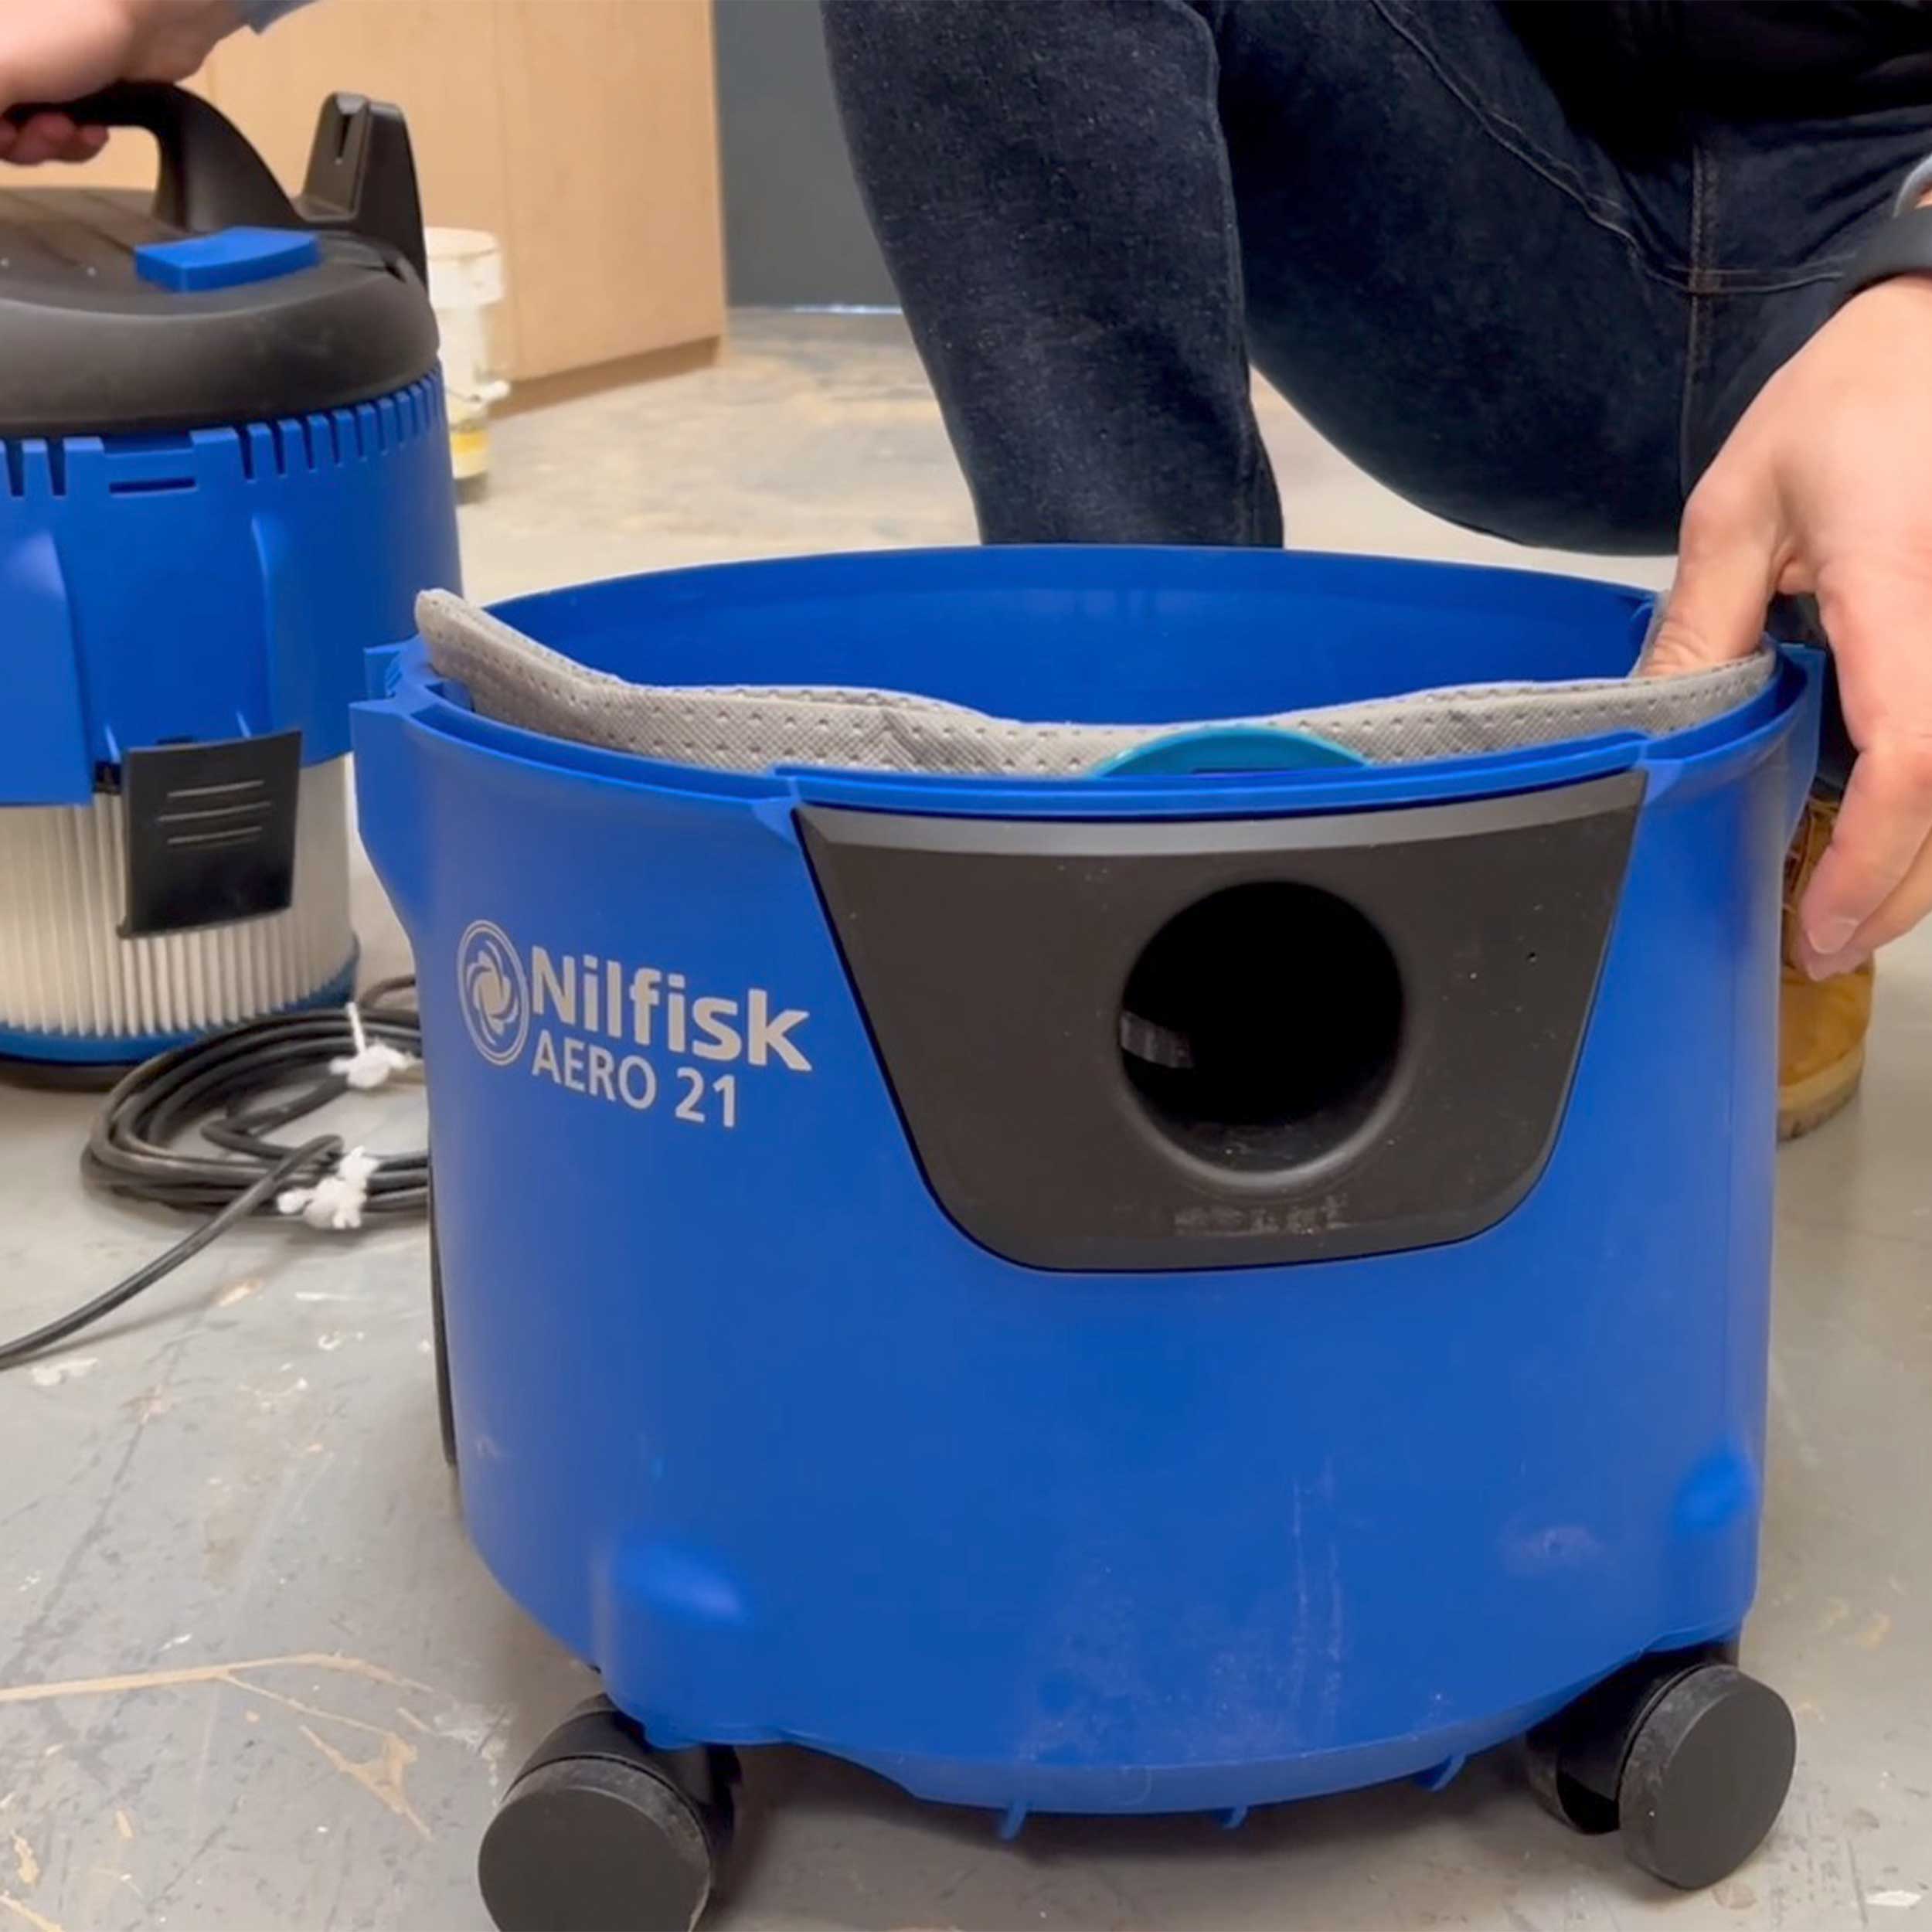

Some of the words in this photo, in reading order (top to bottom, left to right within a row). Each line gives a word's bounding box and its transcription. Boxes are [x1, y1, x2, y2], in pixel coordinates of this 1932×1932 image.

[532, 946, 811, 1071] Nilfisk
[532, 1029, 656, 1109] AERO
[675, 1067, 736, 1128] 21
